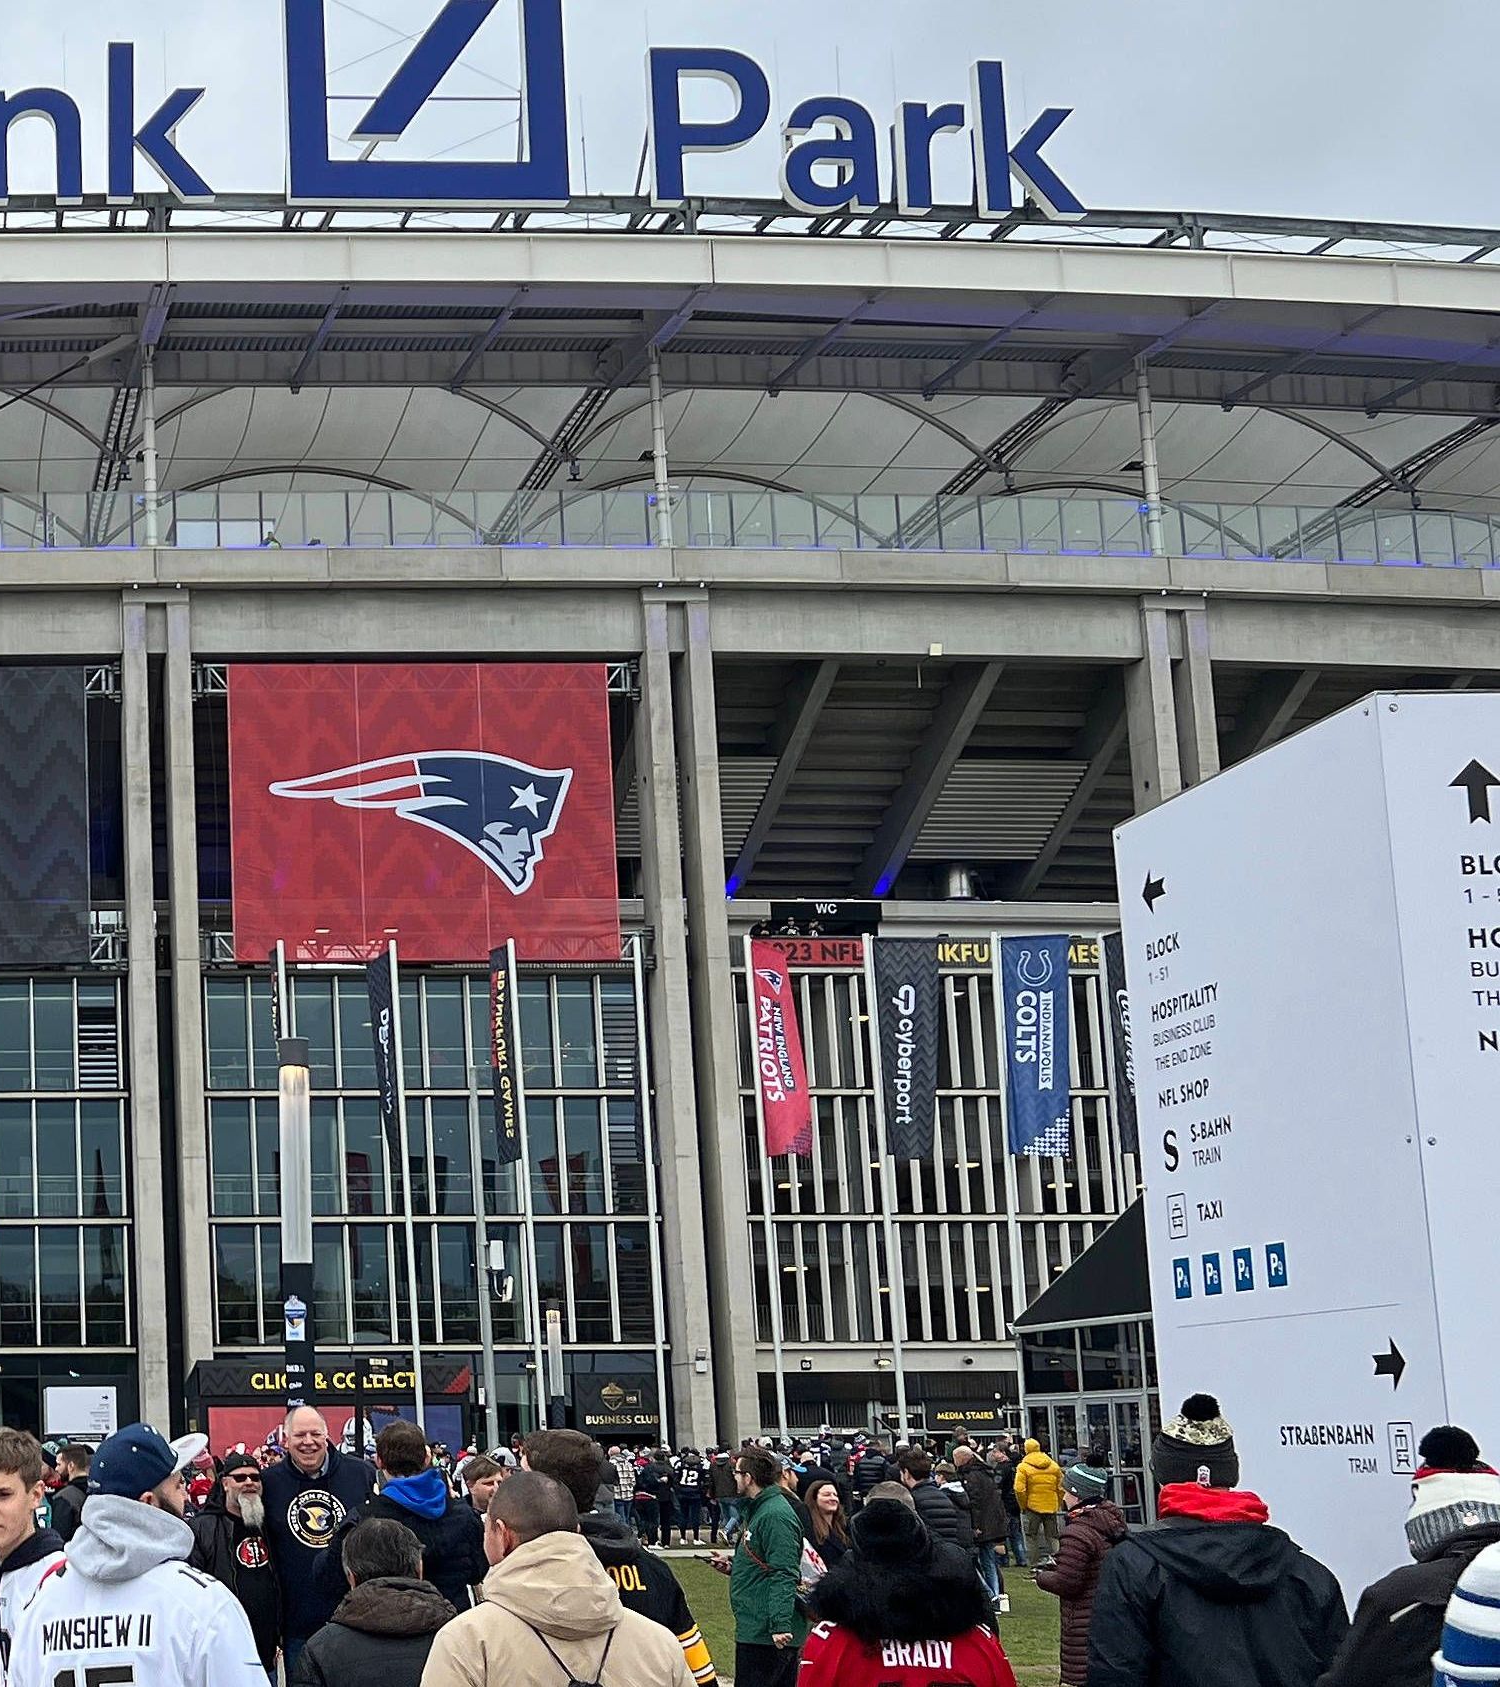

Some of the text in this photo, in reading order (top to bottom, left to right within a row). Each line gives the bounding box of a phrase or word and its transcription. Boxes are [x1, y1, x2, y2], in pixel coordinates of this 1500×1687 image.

[647, 47, 1090, 222] Park
[815, 903, 838, 914] WC
[820, 943, 863, 961] NFL
[1145, 931, 1181, 961] BLOCK
[1151, 981, 1219, 1023] HOSPITALITY
[1015, 990, 1038, 1064] COLTS
[1041, 998, 1052, 1083] INDIANAPOLIS
[1152, 1014, 1216, 1047] BUSINESS CLUB
[758, 995, 787, 1103] PATRIOTS
[772, 1006, 796, 1089] NEW ENGLAND
[1154, 1041, 1212, 1072] THE END ZONE
[894, 1018, 916, 1125] cyberport
[1158, 1078, 1210, 1109] NFL SHOP
[1190, 1115, 1232, 1143] S-BAHN
[1192, 1146, 1222, 1168] TRAIN
[1197, 1199, 1223, 1222] TAXI
[314, 1372, 328, 1389] &
[585, 1414, 659, 1425] BUSINESS CLUB
[936, 1411, 994, 1421] MEDIA STAIRS
[679, 1468, 699, 1486] 12
[1348, 1457, 1378, 1475] TRAM
[42, 1614, 152, 1656] MINSHEW II
[880, 1639, 953, 1670] BRADY
